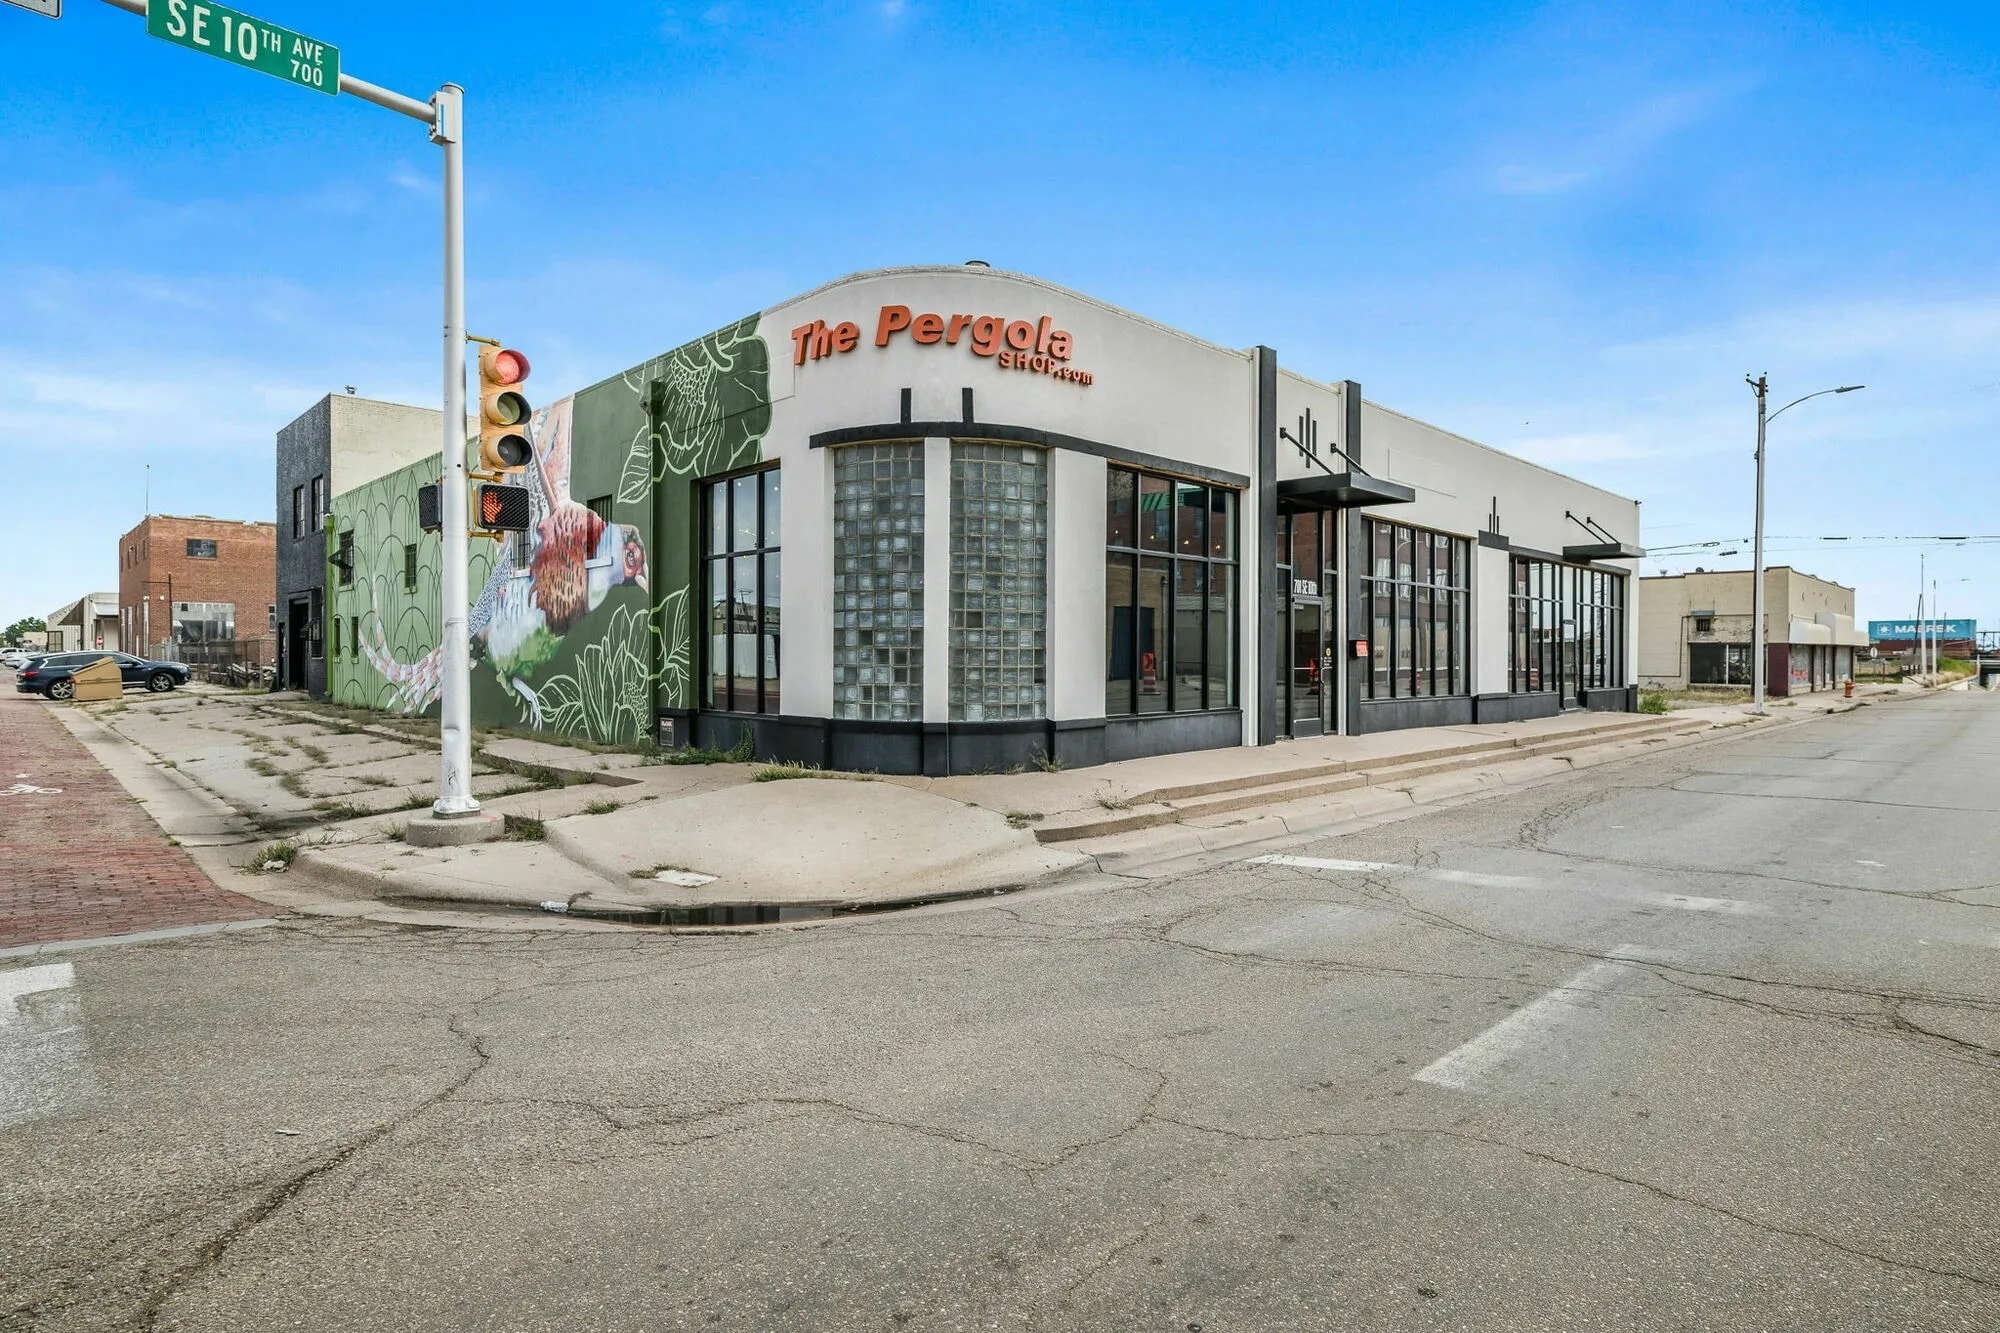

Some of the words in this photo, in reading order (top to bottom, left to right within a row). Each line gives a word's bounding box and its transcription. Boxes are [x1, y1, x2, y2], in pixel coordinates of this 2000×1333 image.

[166, 0, 211, 46] SE
[222, 16, 282, 61] 10TH
[292, 38, 324, 64] AVE
[291, 59, 323, 87] 700
[791, 319, 860, 365] The
[875, 304, 1073, 360] Pergola
[999, 350, 1094, 386] SHOP.com
